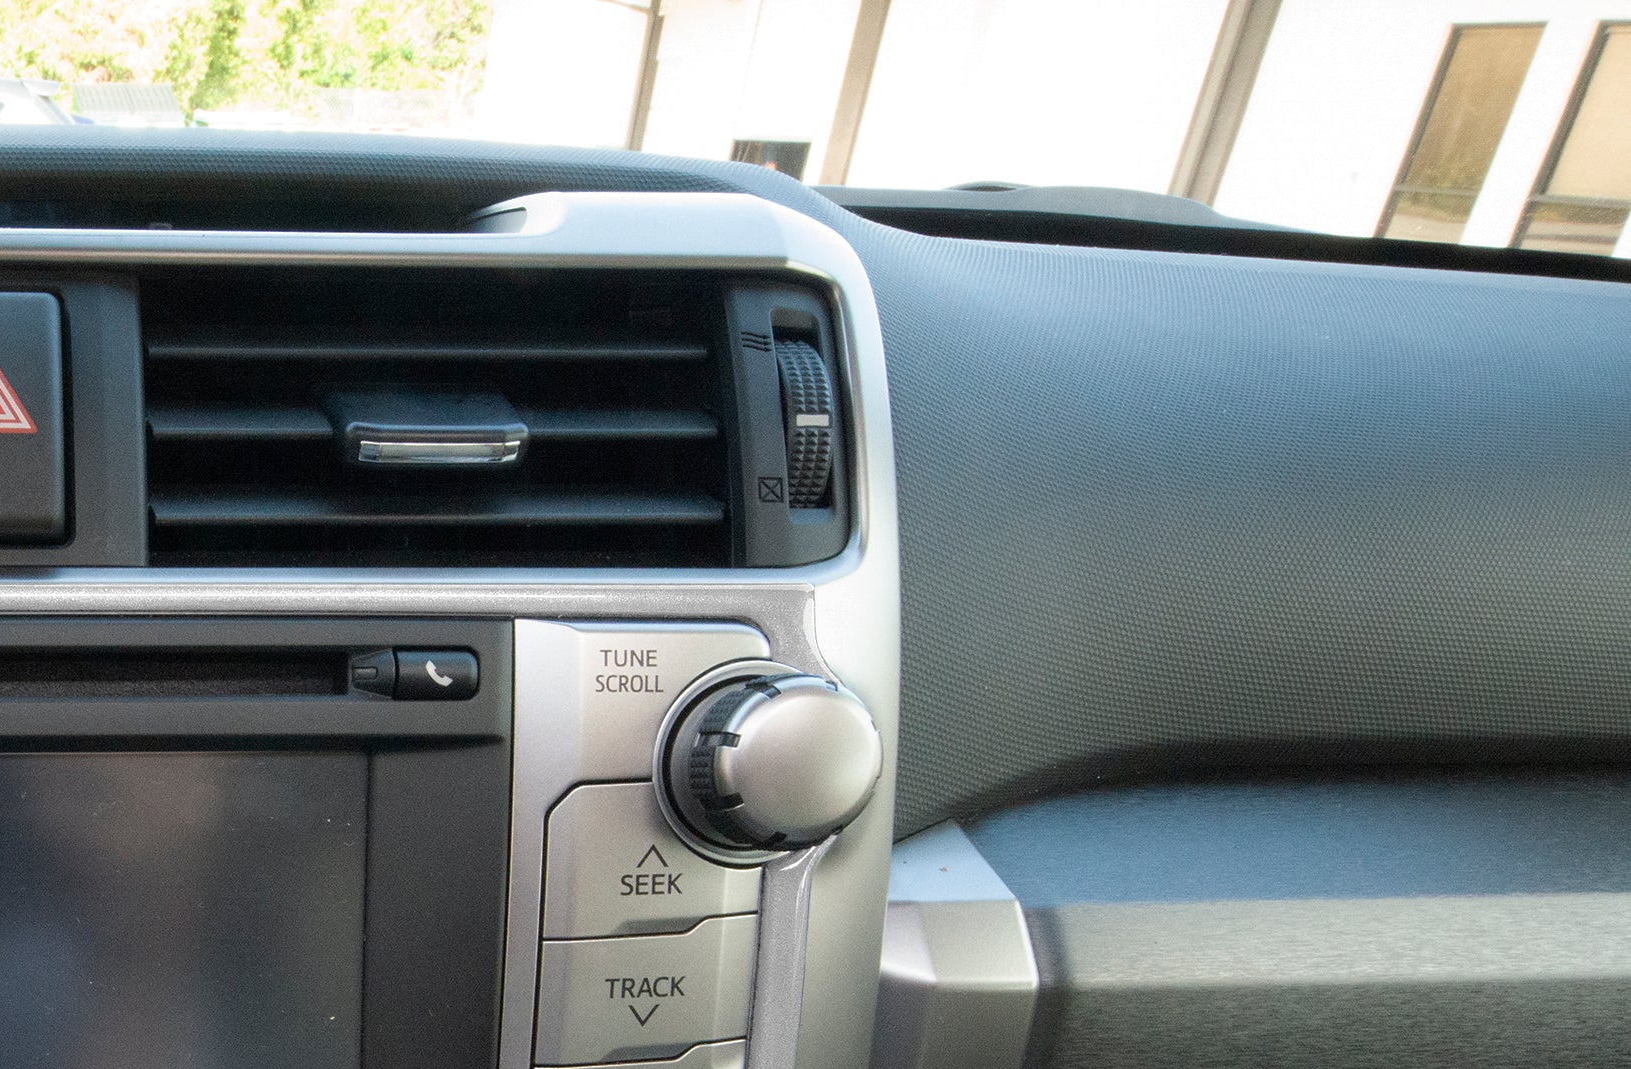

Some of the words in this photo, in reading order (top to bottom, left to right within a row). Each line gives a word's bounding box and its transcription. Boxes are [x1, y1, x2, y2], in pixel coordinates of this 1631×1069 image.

[599, 648, 659, 668] TUNE
[595, 673, 664, 694] SCROLL
[619, 872, 683, 896] SEEK
[605, 975, 686, 999] TRACK
